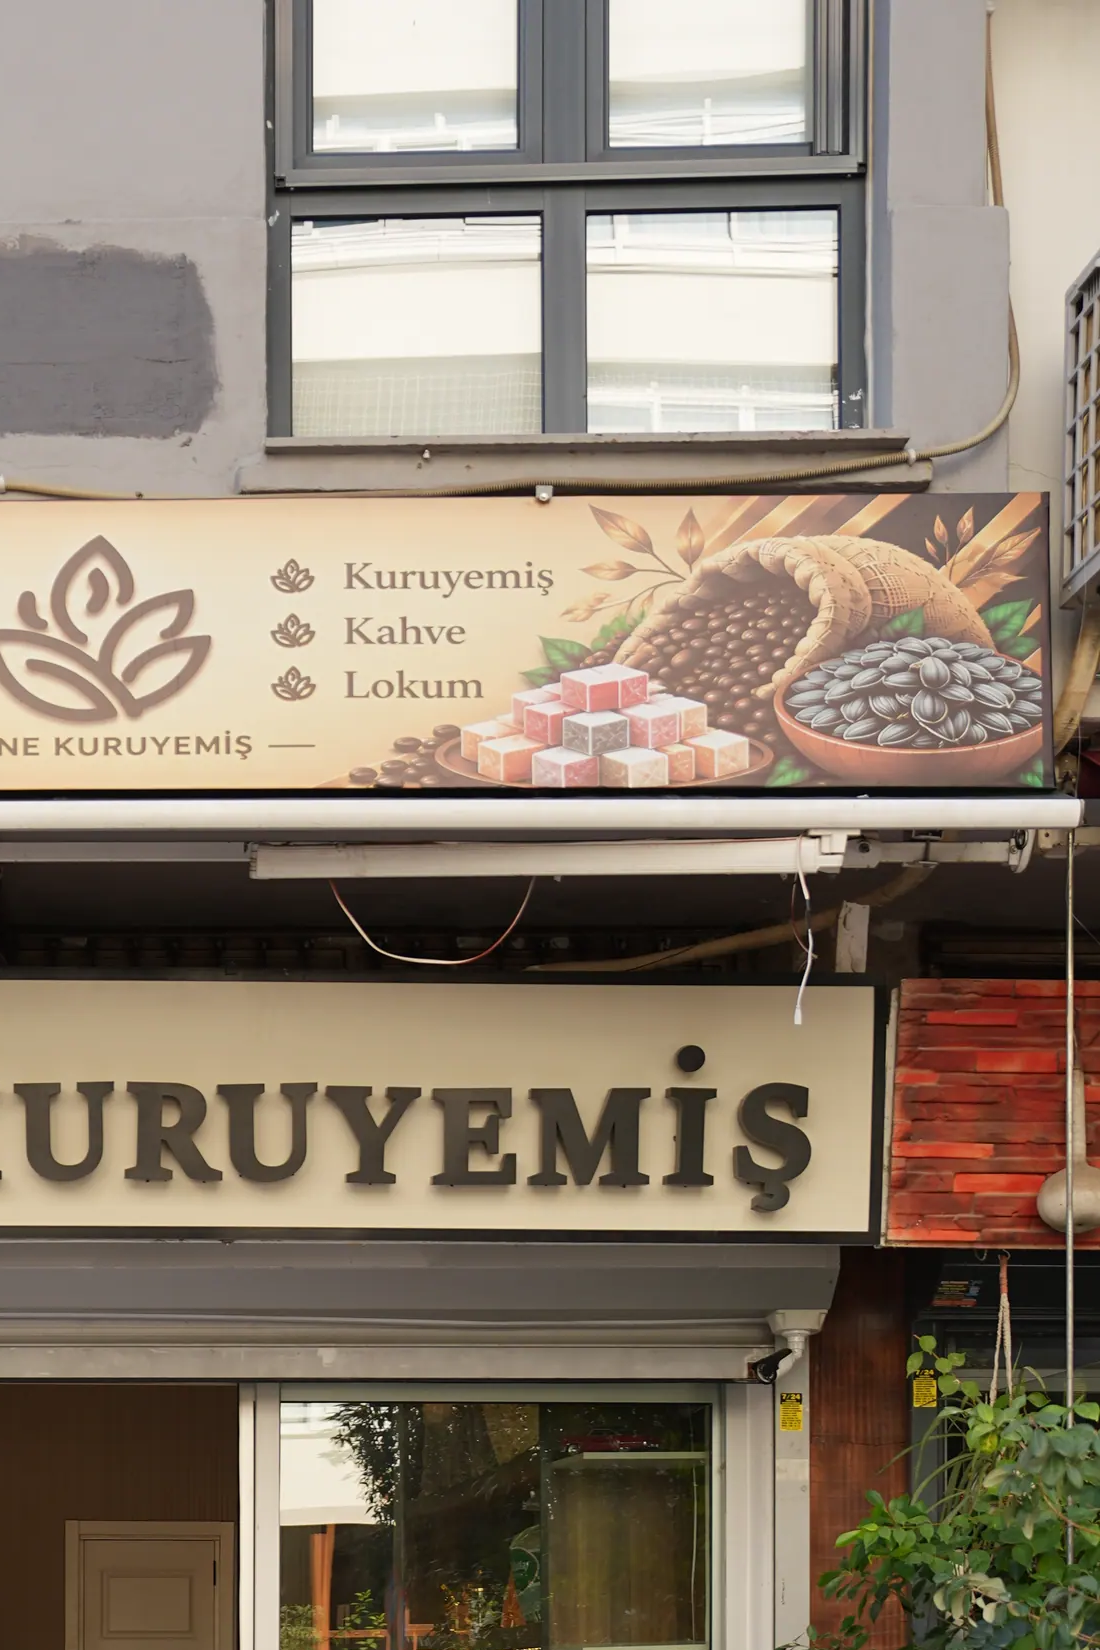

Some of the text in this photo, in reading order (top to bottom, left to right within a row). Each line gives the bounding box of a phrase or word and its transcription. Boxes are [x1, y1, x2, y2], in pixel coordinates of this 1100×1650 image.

[343, 561, 555, 599] Kuruyemiş
[343, 616, 467, 647] Kahve
[343, 671, 485, 700] Lokum
[54, 730, 254, 760] KURUYEMİŞ
